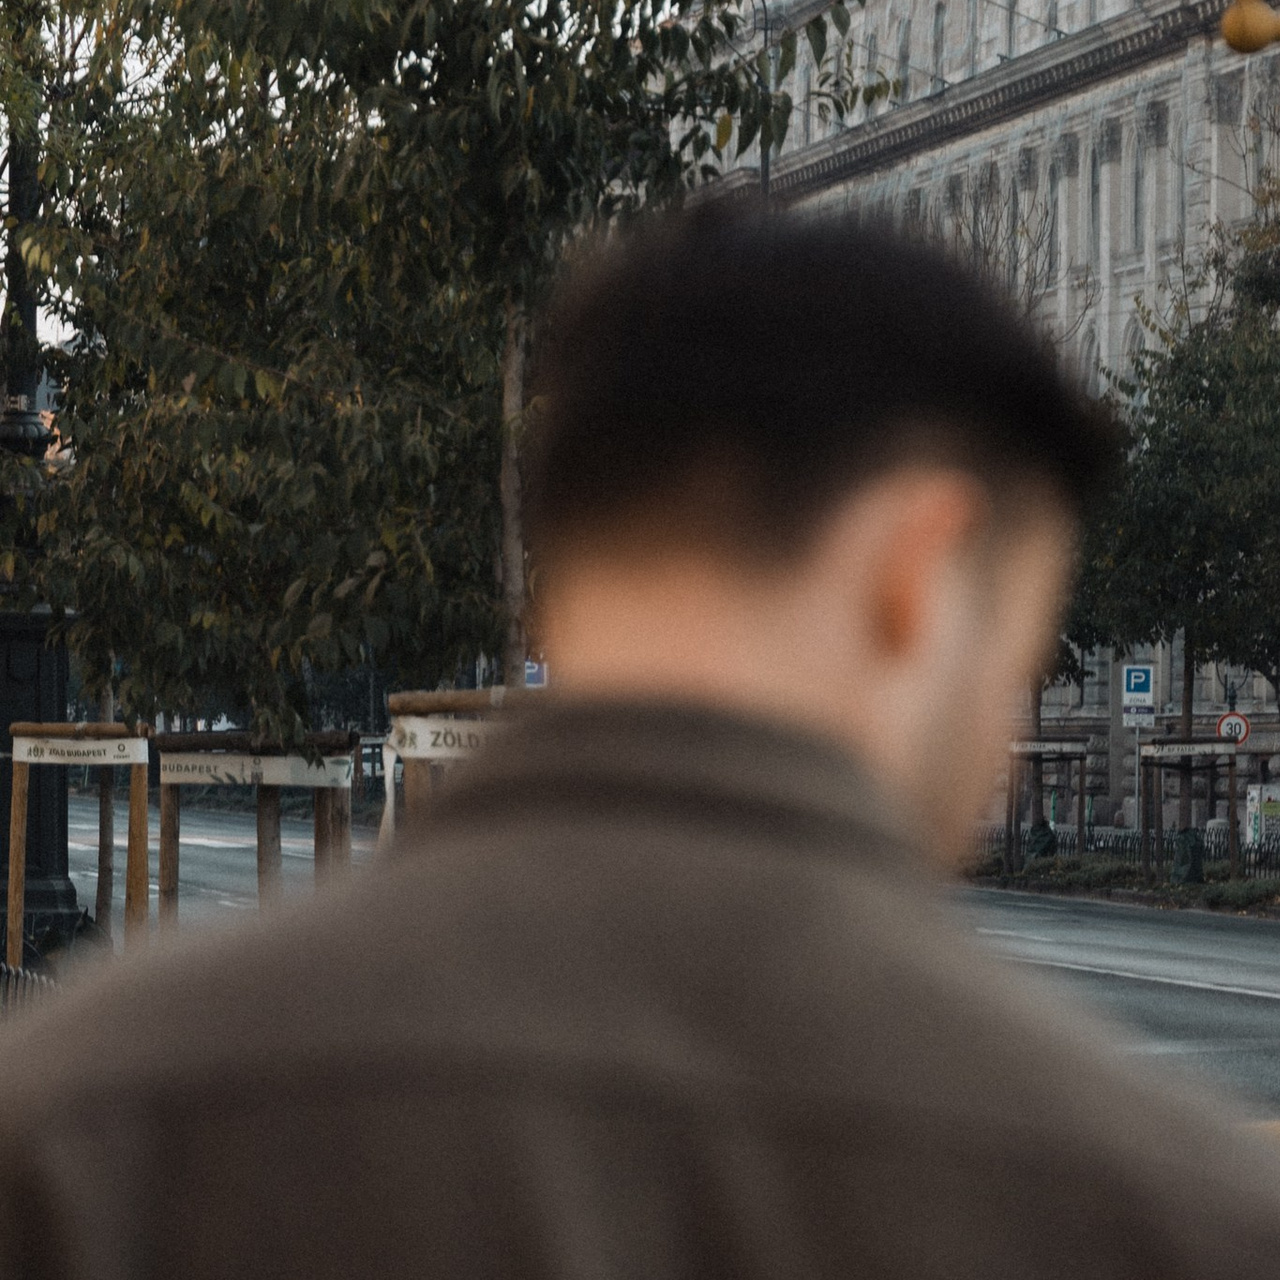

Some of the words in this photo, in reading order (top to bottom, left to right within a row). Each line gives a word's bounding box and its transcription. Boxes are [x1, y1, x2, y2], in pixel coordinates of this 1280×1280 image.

[1130, 671, 1146, 691] P
[430, 727, 480, 750] ZÖLD
[1226, 722, 1242, 737] 30
